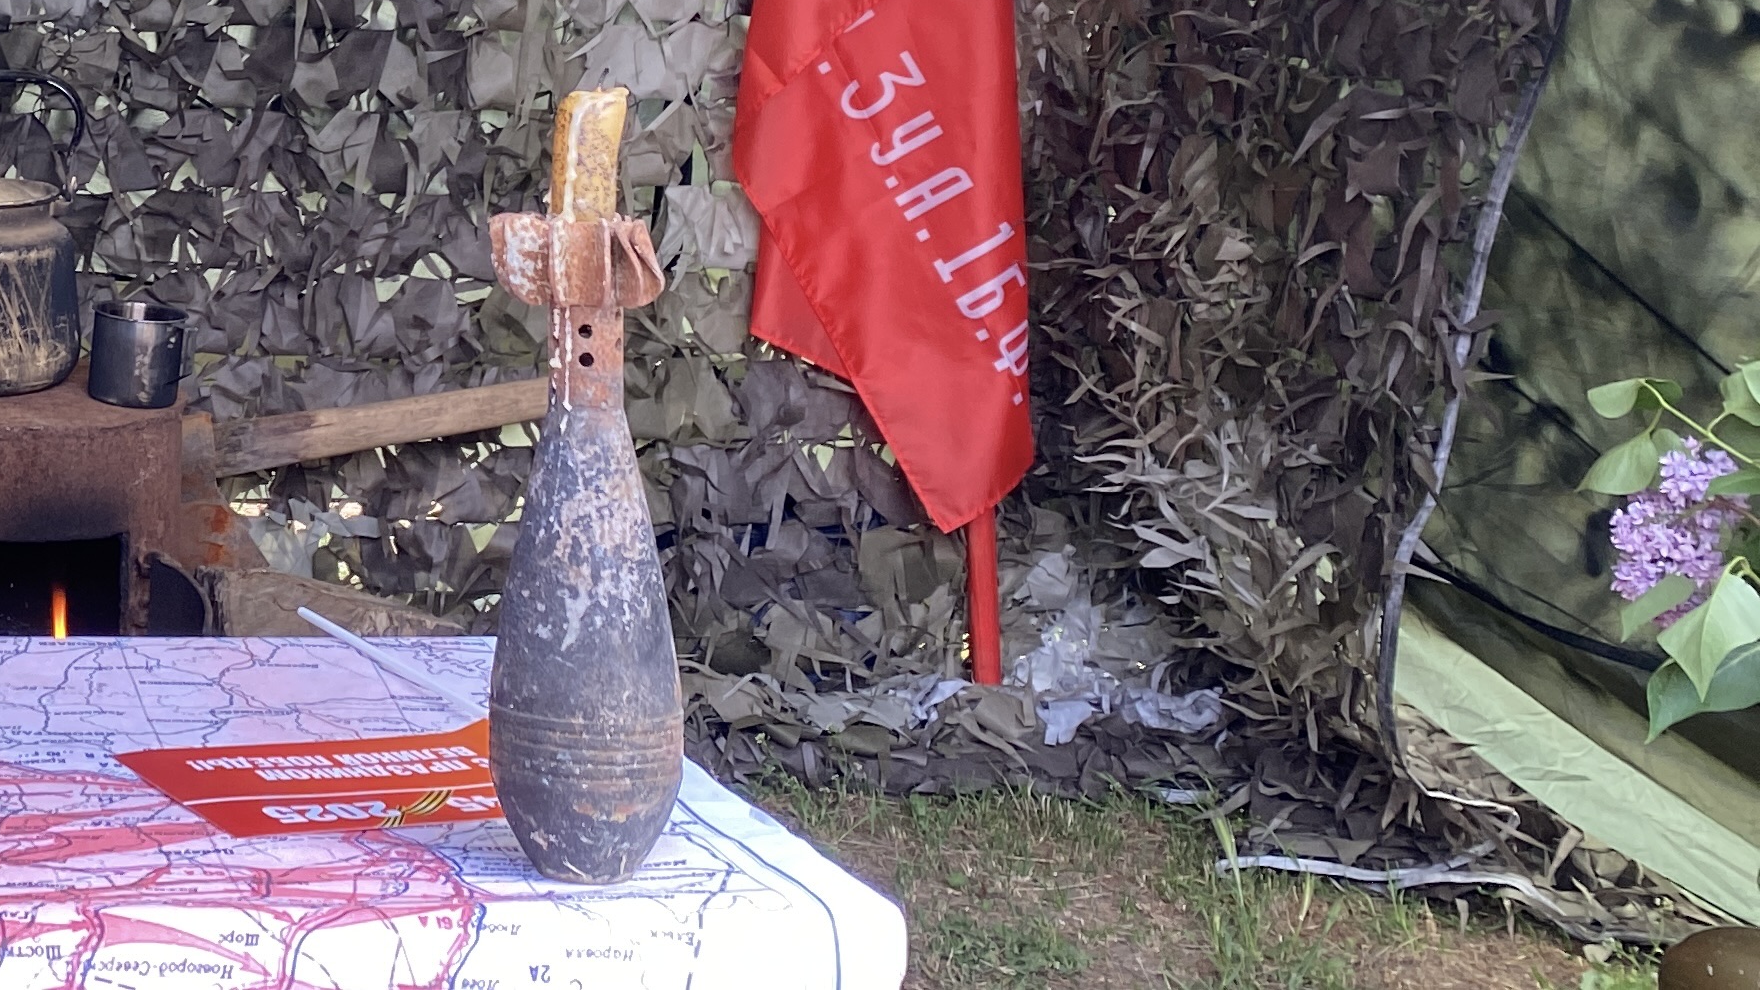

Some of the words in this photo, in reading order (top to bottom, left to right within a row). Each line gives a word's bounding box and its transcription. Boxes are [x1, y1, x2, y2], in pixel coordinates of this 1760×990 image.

[185, 756, 334, 771] ПОБЕДЫ!
[332, 746, 478, 767] ВЕЛИКОЙ
[471, 757, 490, 769] С
[255, 759, 472, 781] ПРАЗДНИКОМ
[261, 800, 401, 824] 2025
[418, 916, 429, 929] А
[436, 916, 453, 930] 61
